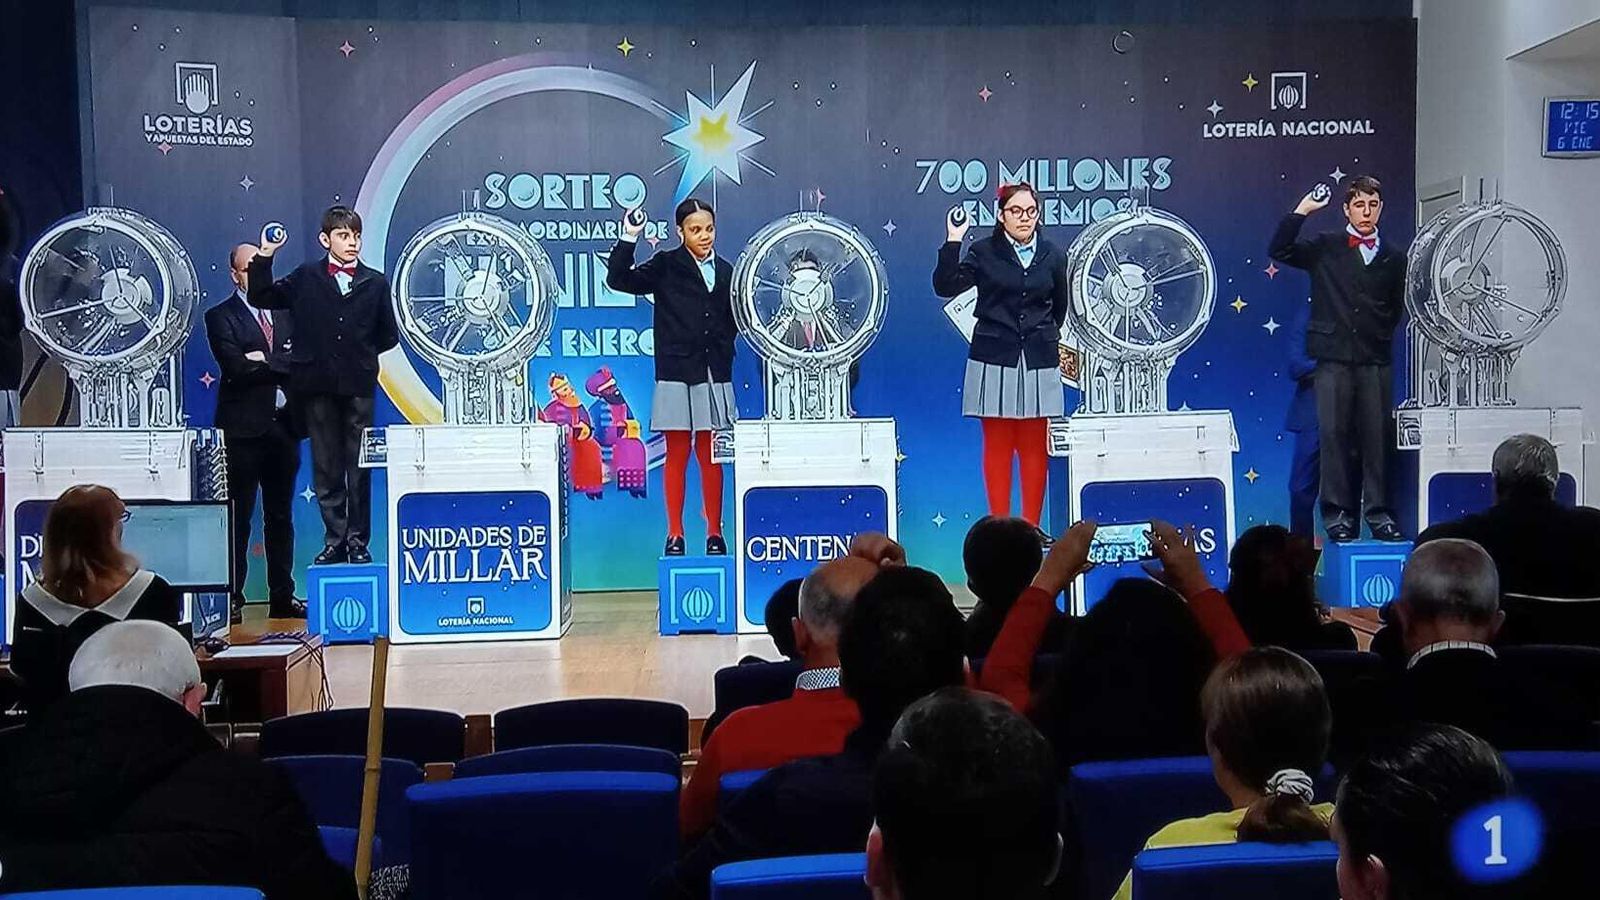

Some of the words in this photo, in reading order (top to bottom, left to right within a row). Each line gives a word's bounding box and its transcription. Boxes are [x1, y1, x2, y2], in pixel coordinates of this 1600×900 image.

[144, 114, 253, 135] LOTERÍAS
[1203, 119, 1276, 138] LOTERÍA
[1282, 120, 1375, 136] NACIONAL
[199, 135, 217, 145] DEL
[217, 136, 253, 146] ESTADO
[916, 159, 988, 193] 700
[999, 157, 1172, 191] MILLONES
[484, 173, 647, 210] SORTEO
[645, 221, 668, 240] DE
[402, 526, 512, 548] UNIDADES
[517, 525, 547, 546] DE
[747, 535, 850, 561] CENTEN
[403, 549, 548, 584] MILLAR
[472, 615, 514, 627] NACIONAL
